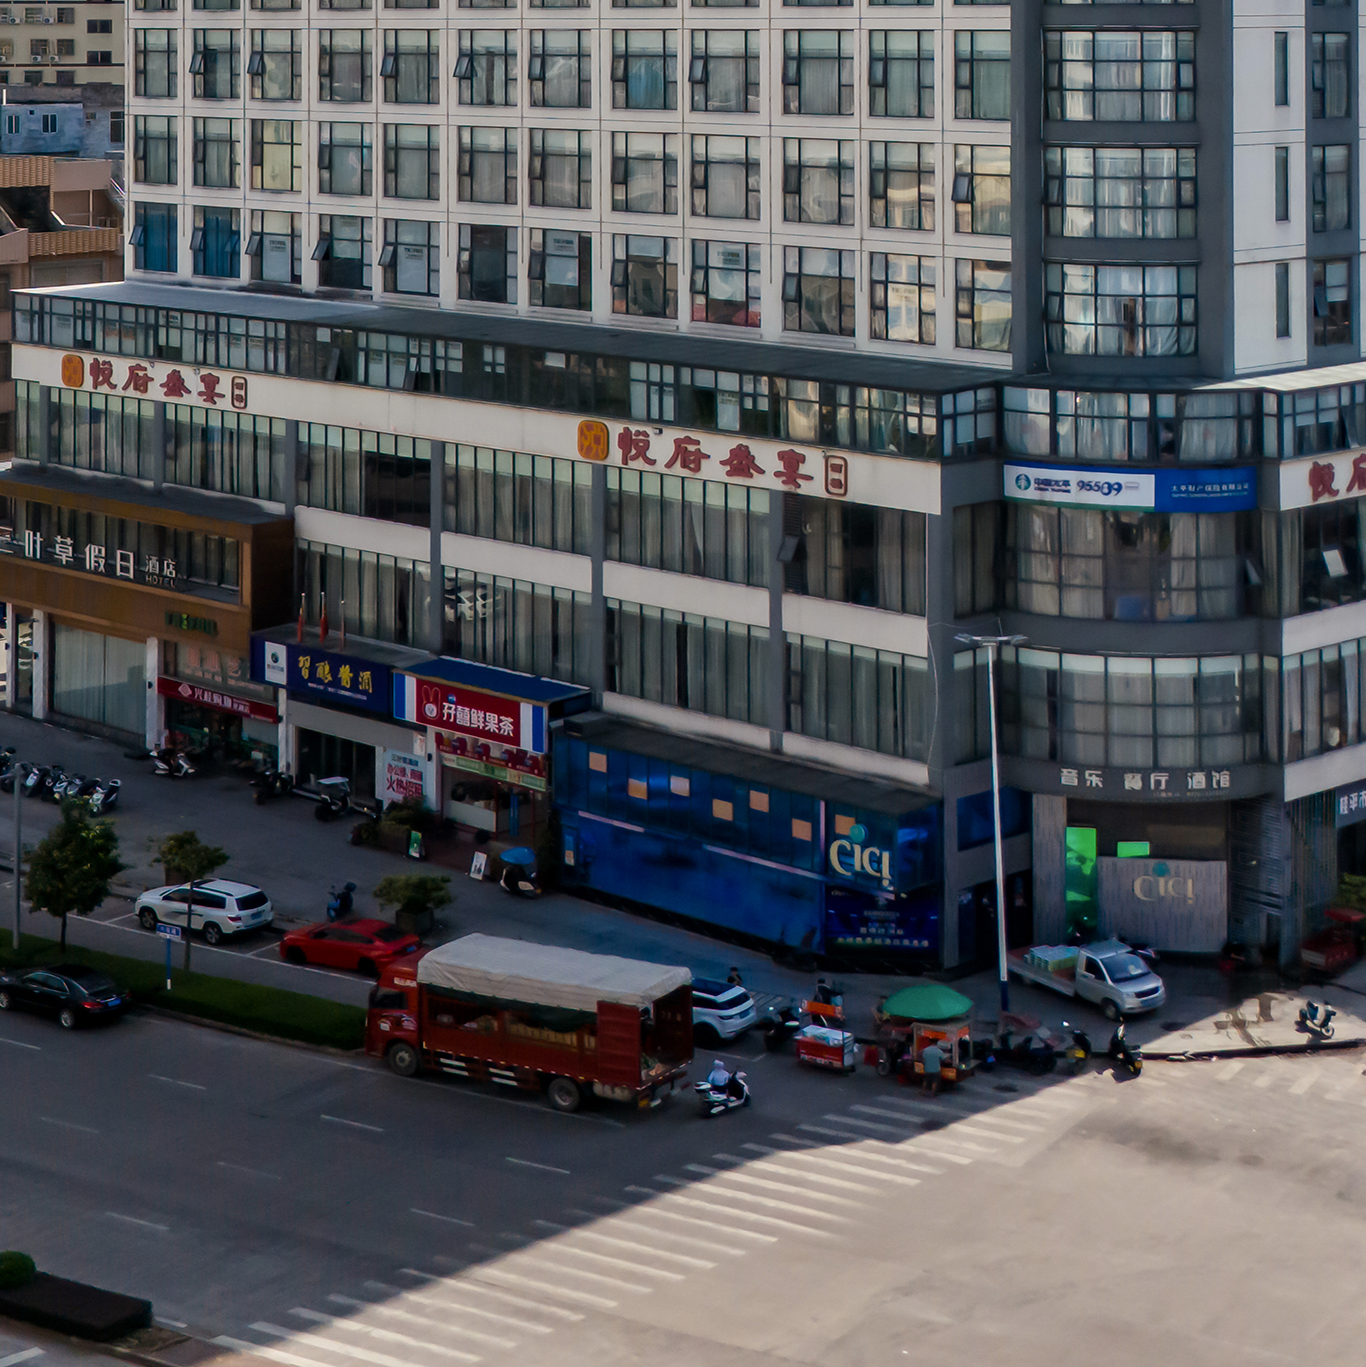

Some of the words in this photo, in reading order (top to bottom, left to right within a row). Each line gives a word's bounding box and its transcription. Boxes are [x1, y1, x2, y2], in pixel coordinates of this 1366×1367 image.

[617, 426, 814, 488] 悦府盛宴
[1076, 480, 1123, 496] 95589
[146, 574, 177, 588] HOTEL
[1060, 768, 1104, 788] 音乐
[1124, 772, 1170, 790] 餐厅
[1187, 770, 1231, 790] 酒馆
